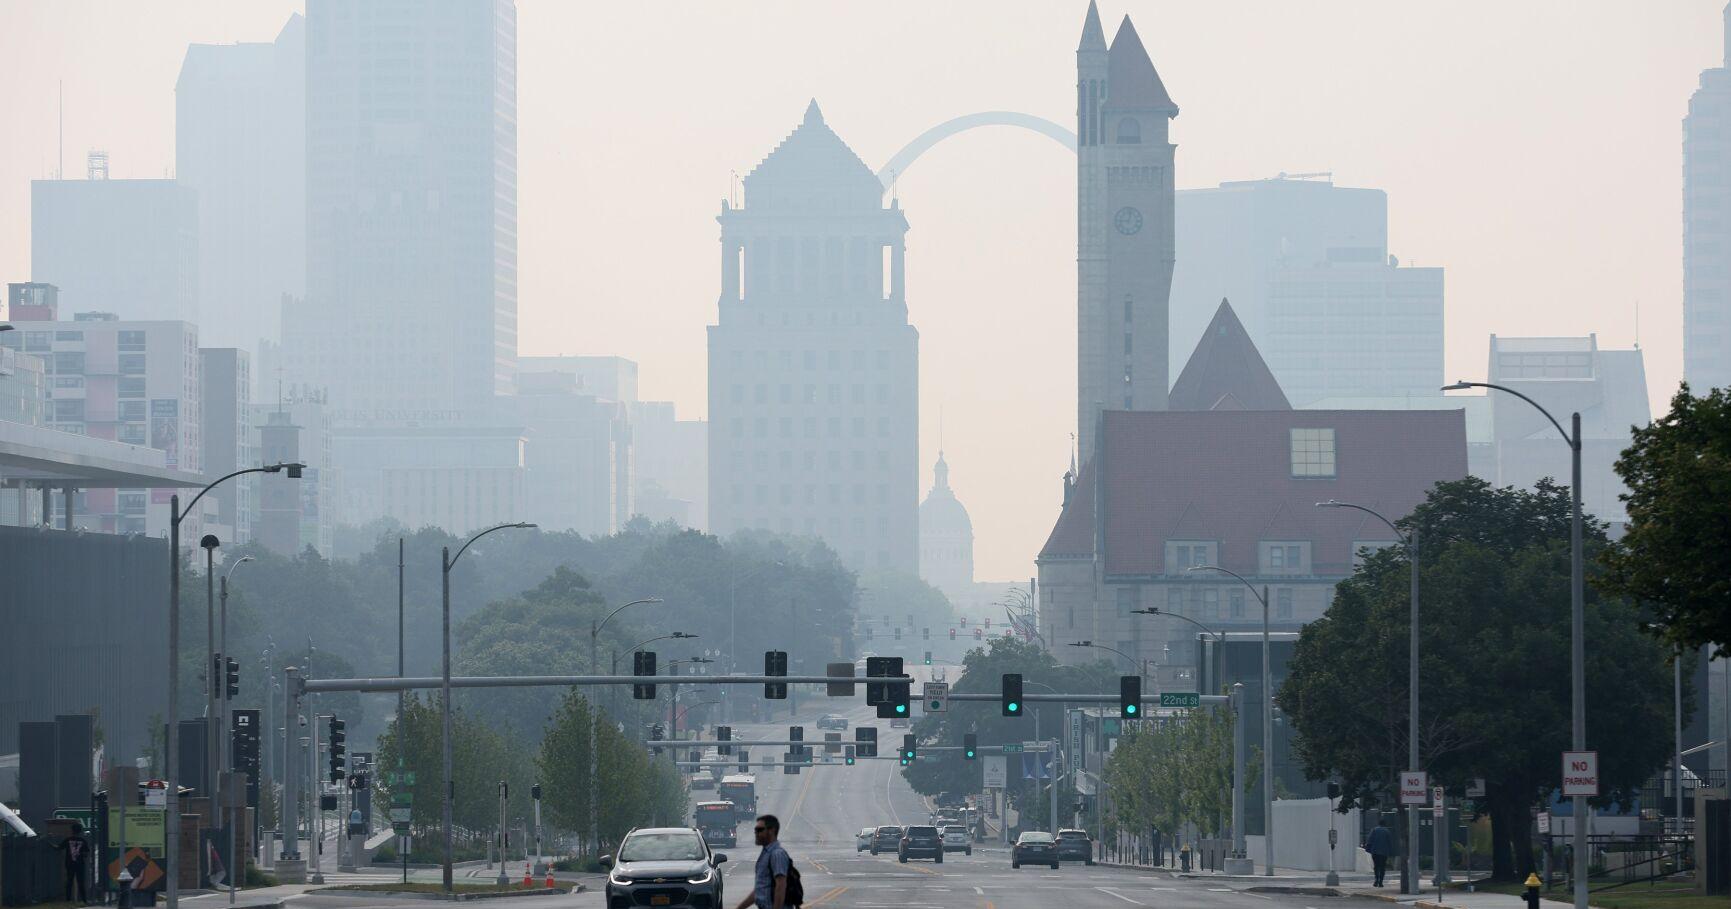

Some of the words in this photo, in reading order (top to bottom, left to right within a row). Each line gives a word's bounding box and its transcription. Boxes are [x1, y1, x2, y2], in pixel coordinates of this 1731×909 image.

[1163, 695, 1188, 705] 22nd
[1190, 697, 1198, 705] St
[1572, 761, 1588, 771] NO
[1407, 778, 1420, 786] NO
[1565, 777, 1596, 785] PARKING
